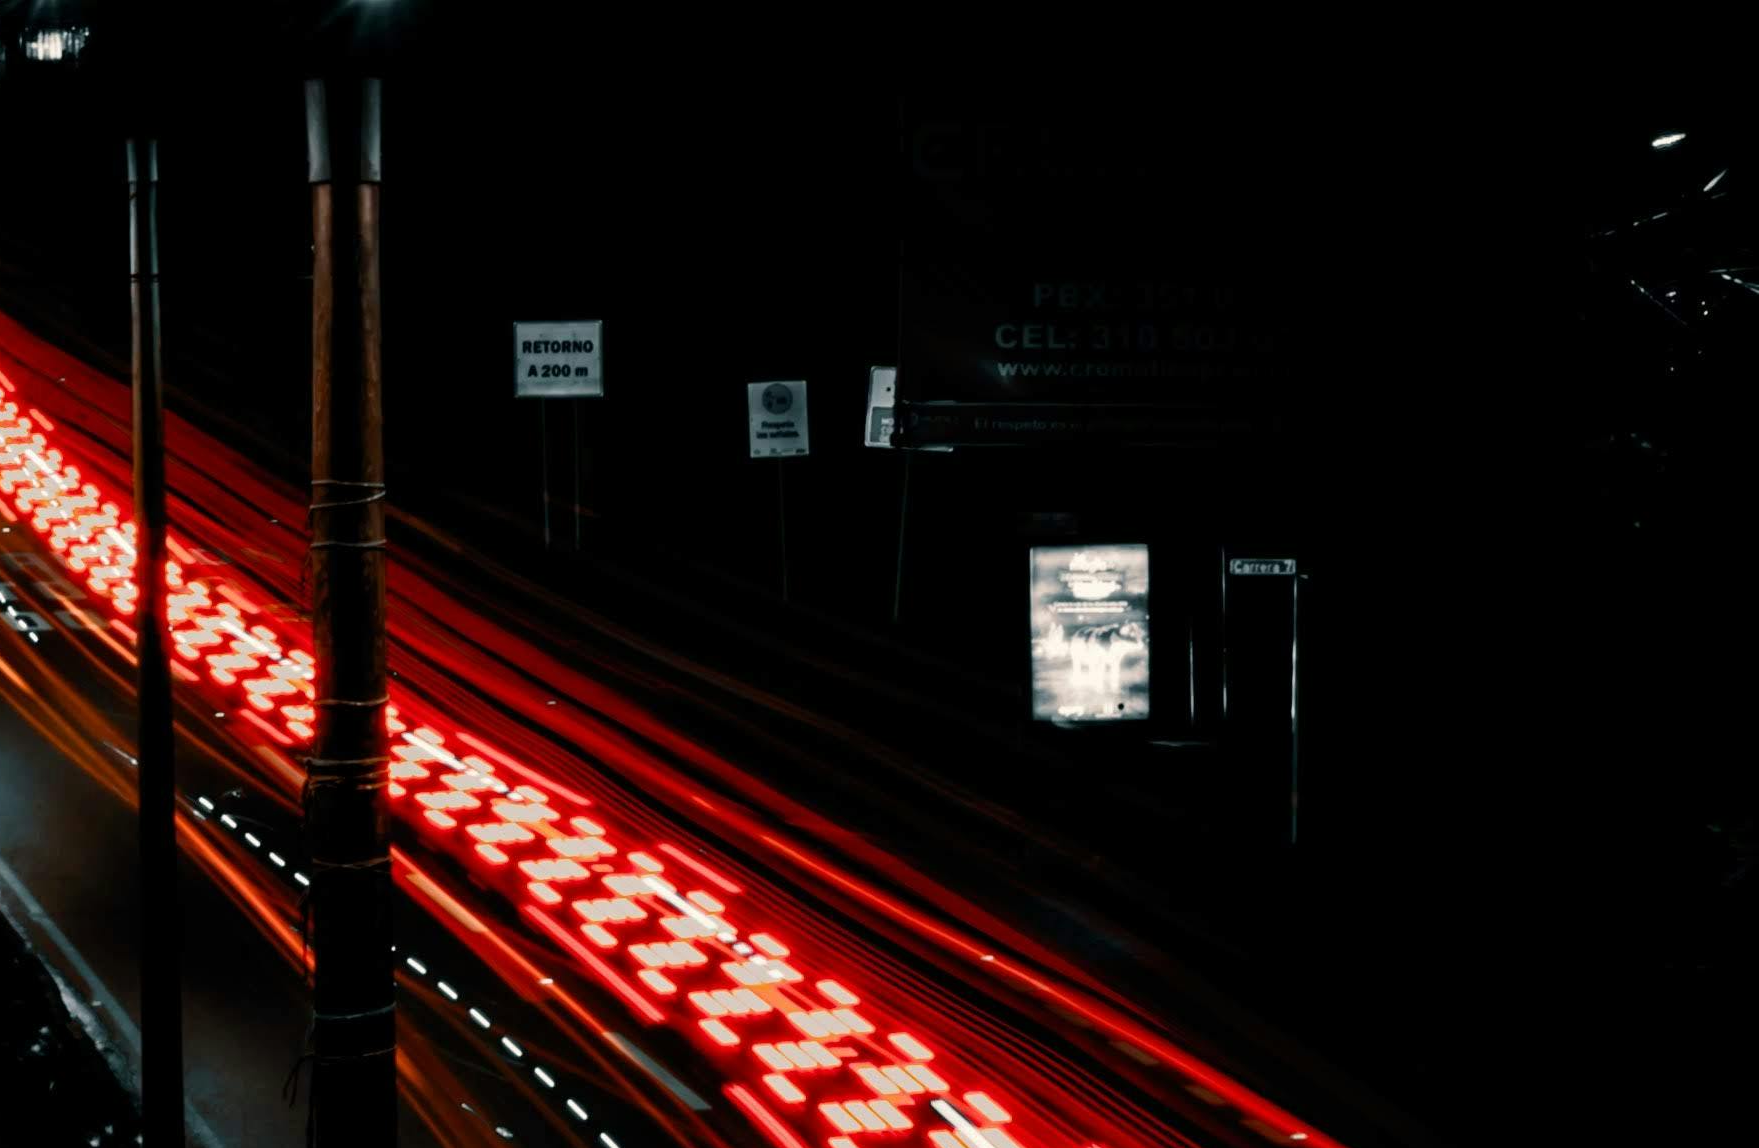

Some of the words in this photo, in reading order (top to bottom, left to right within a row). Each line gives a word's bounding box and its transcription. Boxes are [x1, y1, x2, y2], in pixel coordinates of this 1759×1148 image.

[994, 324, 1078, 350] CEL:
[522, 340, 594, 354] RETORNO
[527, 364, 539, 378] A
[541, 364, 572, 378] 200
[575, 366, 589, 377] m
[1234, 560, 1281, 574] Carrera
[1283, 559, 1294, 573] 7
